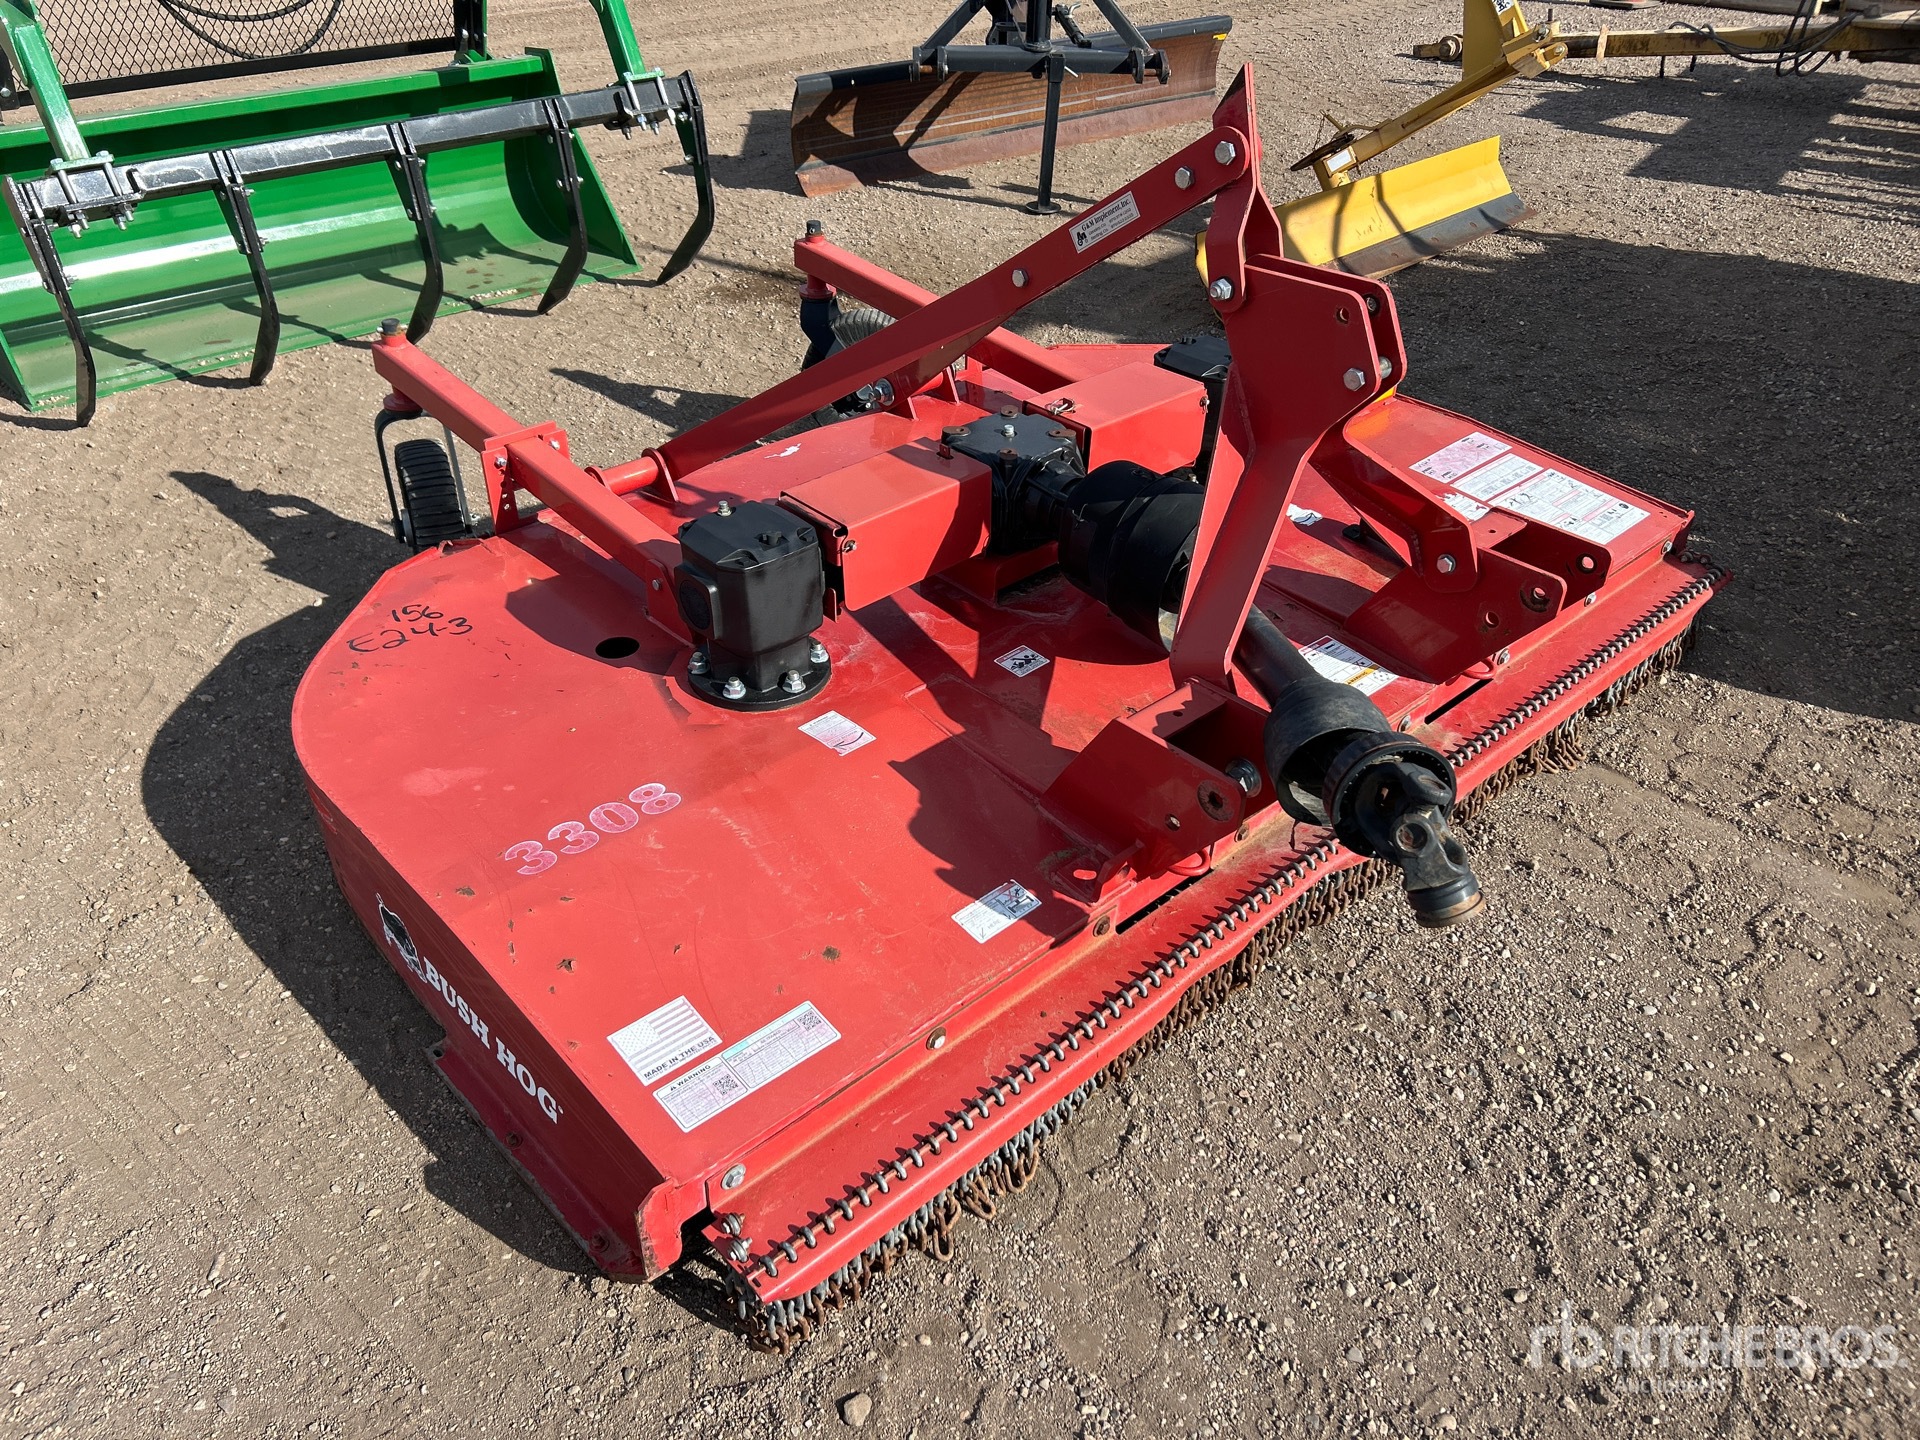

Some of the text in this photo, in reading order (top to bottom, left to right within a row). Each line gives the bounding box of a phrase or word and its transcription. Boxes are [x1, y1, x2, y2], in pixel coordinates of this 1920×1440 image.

[1121, 199, 1131, 207] Inc.
[391, 604, 444, 623] 156
[504, 782, 682, 875] 3308
[424, 956, 558, 1124] BUSH HOG
[643, 1036, 715, 1078] MADE IN THE USA
[676, 1064, 711, 1086] WARNING
